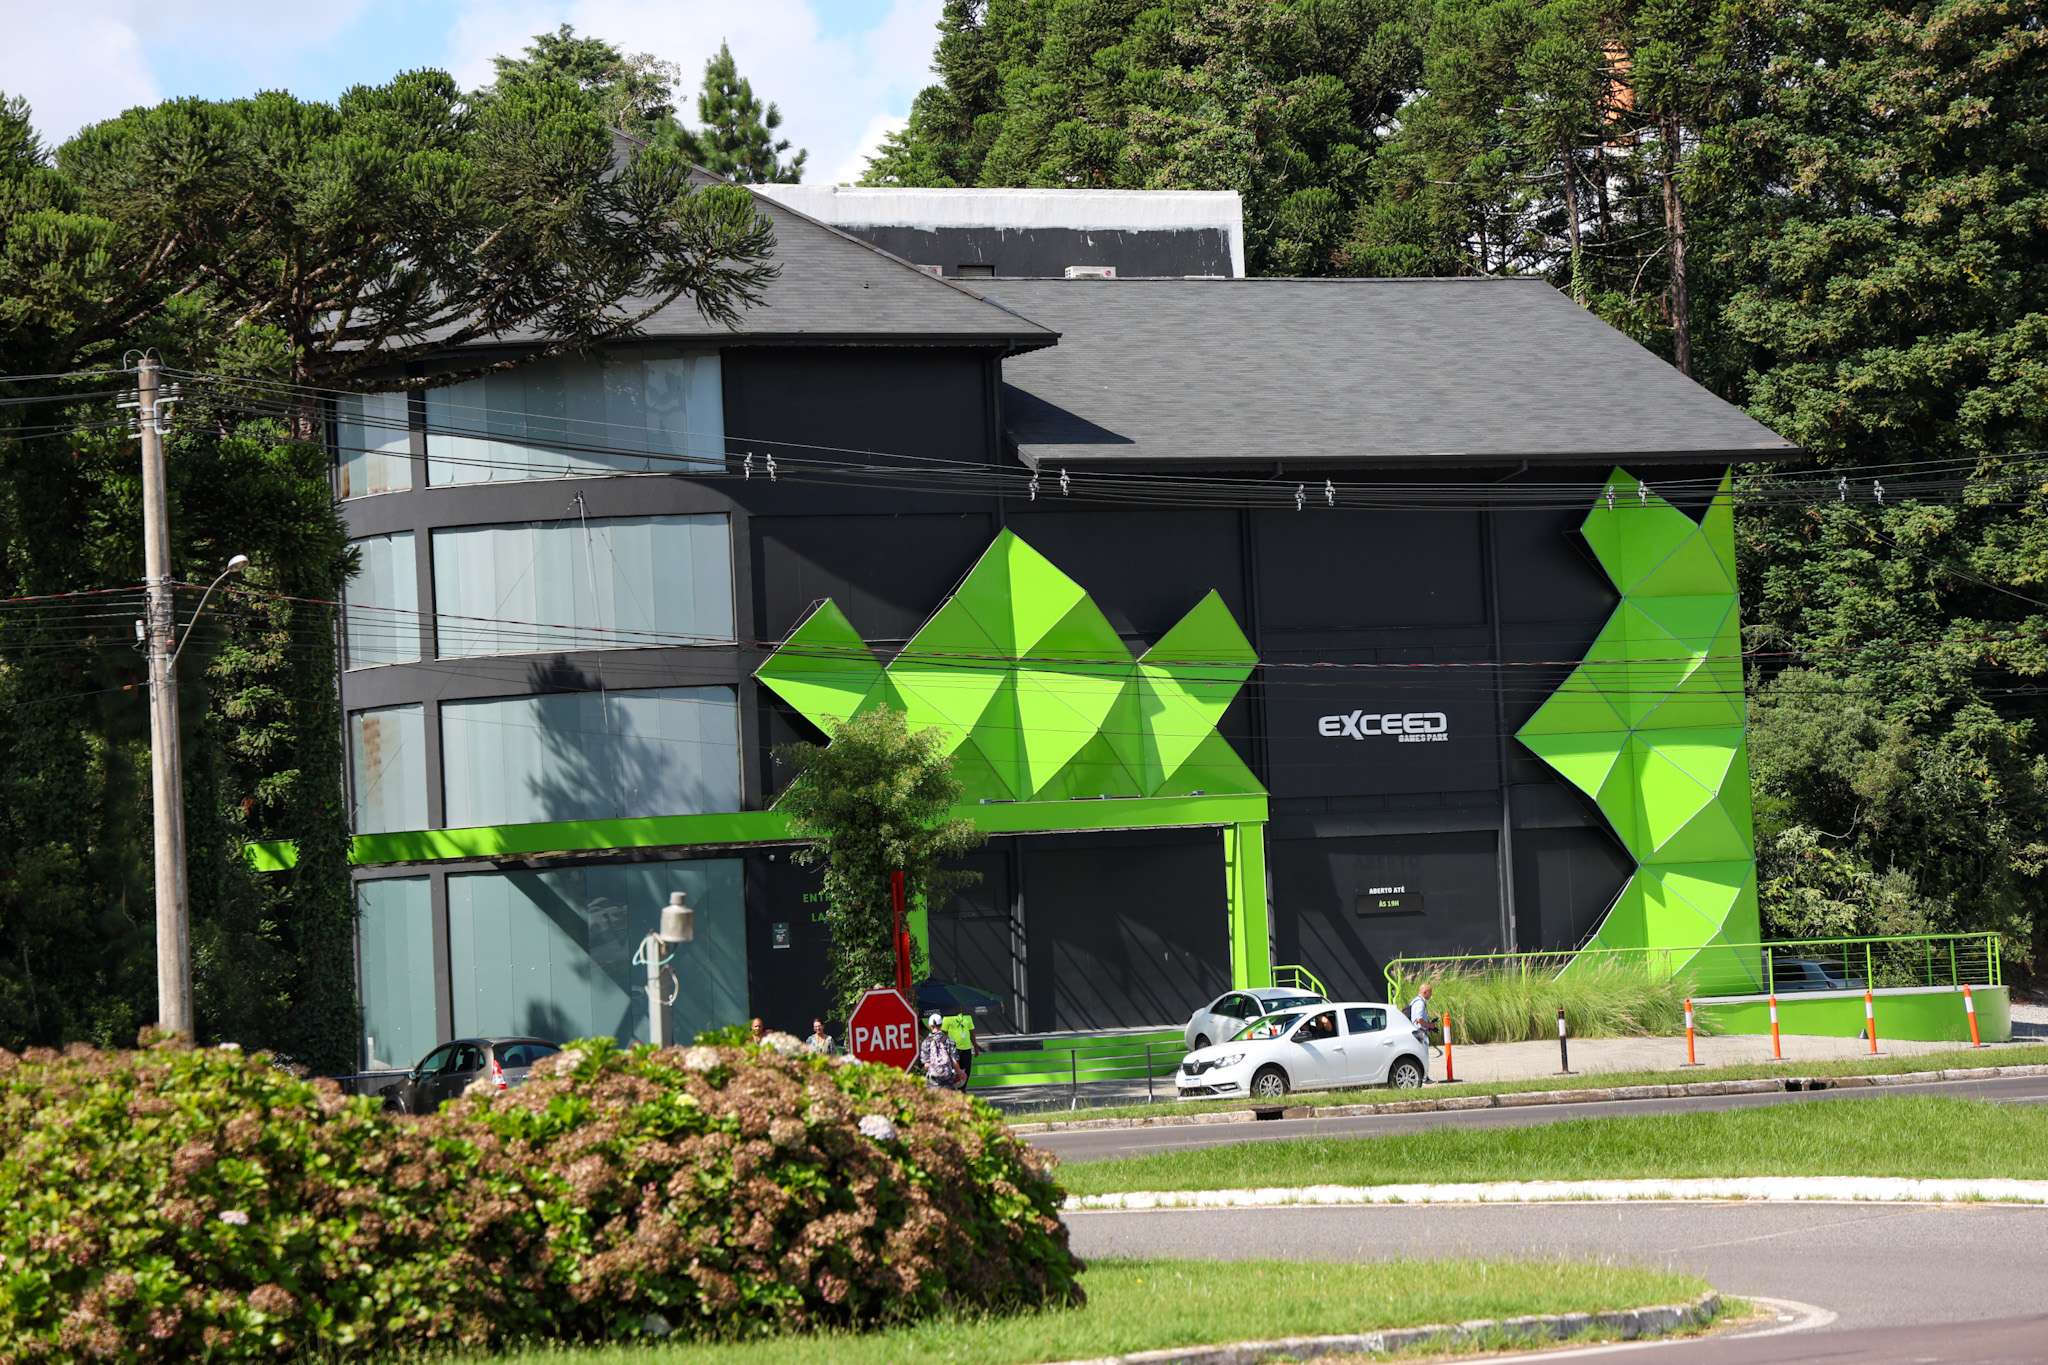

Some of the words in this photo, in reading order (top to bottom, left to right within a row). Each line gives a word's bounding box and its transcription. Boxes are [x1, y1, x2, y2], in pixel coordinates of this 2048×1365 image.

[1398, 734, 1425, 743] GAMES
[1427, 733, 1448, 742] PARK
[1369, 887, 1393, 895] ABERTO
[1393, 885, 1405, 894] ATÉ
[855, 1023, 913, 1053] PARE
